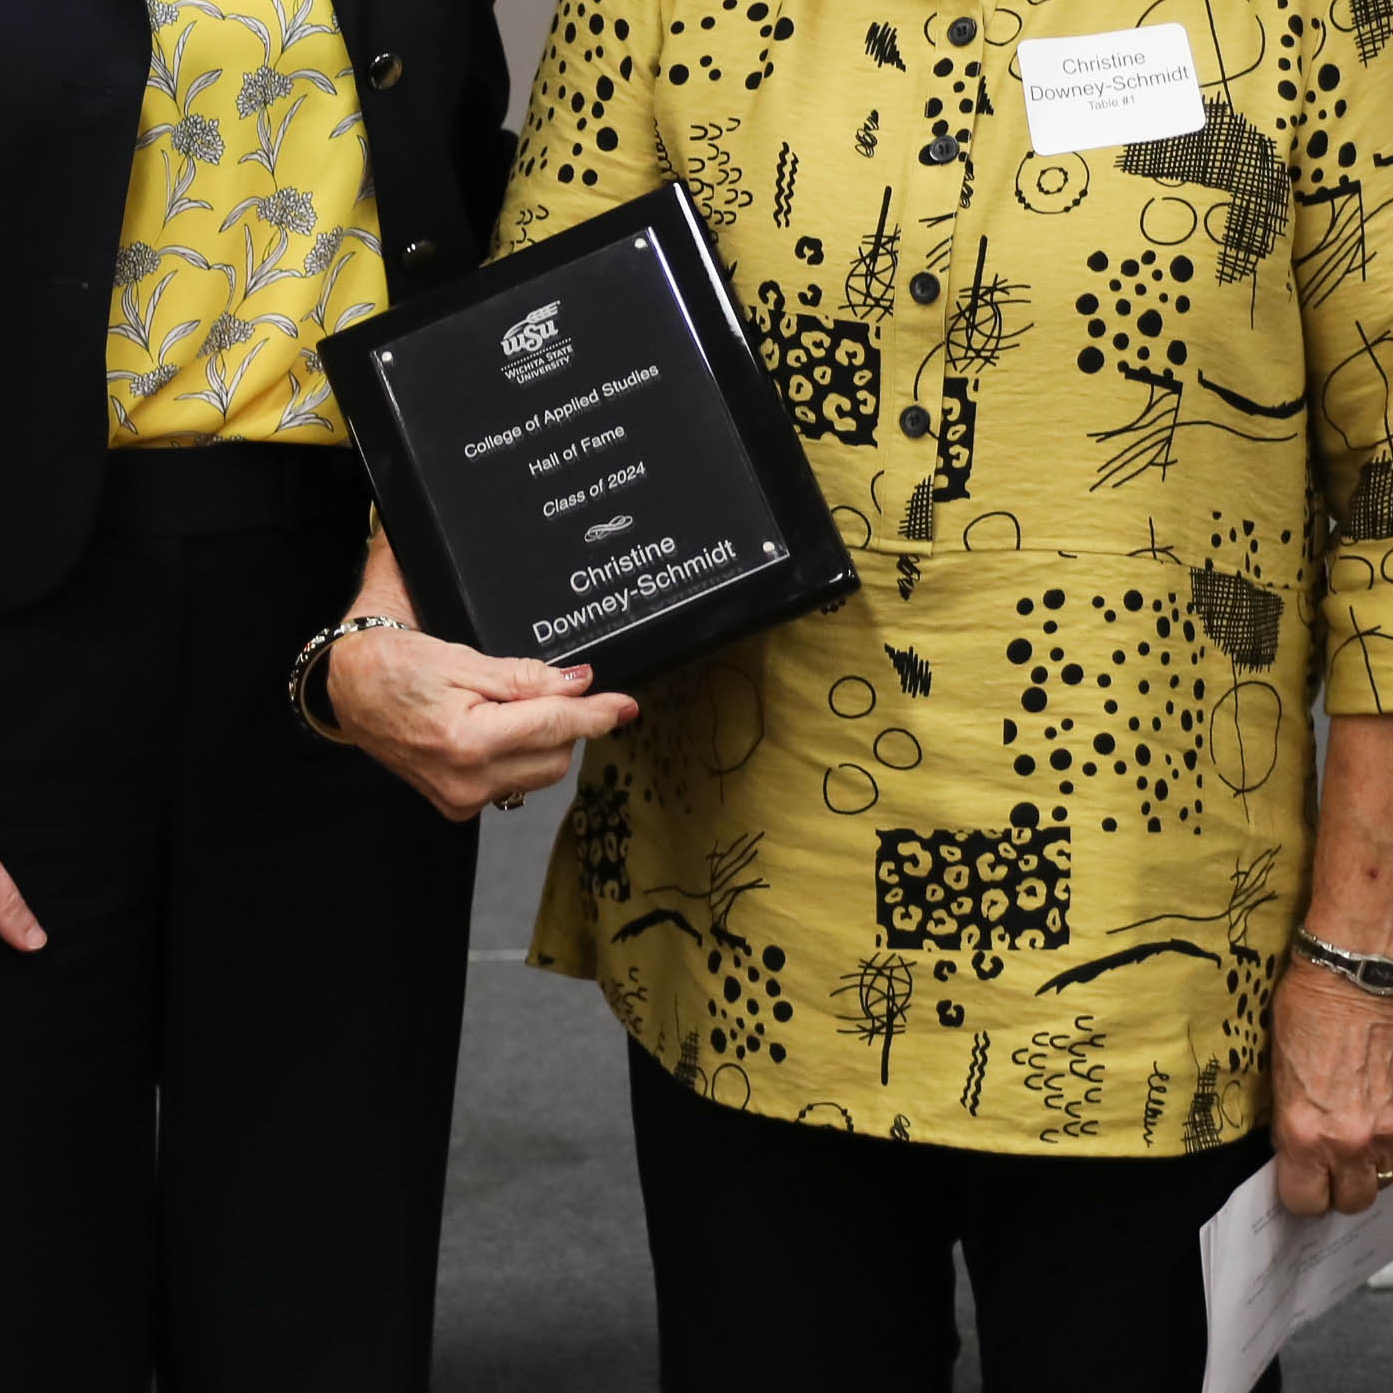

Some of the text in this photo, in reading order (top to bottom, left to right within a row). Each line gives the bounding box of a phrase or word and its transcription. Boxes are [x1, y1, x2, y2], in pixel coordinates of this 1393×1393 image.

[1030, 65, 1190, 102] Downey-Schmidt
[1062, 52, 1146, 76] Christine
[1088, 94, 1136, 111] Table #1
[516, 355, 570, 384] UNIVERSITY
[464, 365, 659, 458] College of Applied Studies
[528, 426, 625, 476] Hall of Fame
[543, 461, 646, 517] Class of 2024
[569, 536, 676, 593] Christine
[532, 539, 737, 644] Downey-Schmidt
